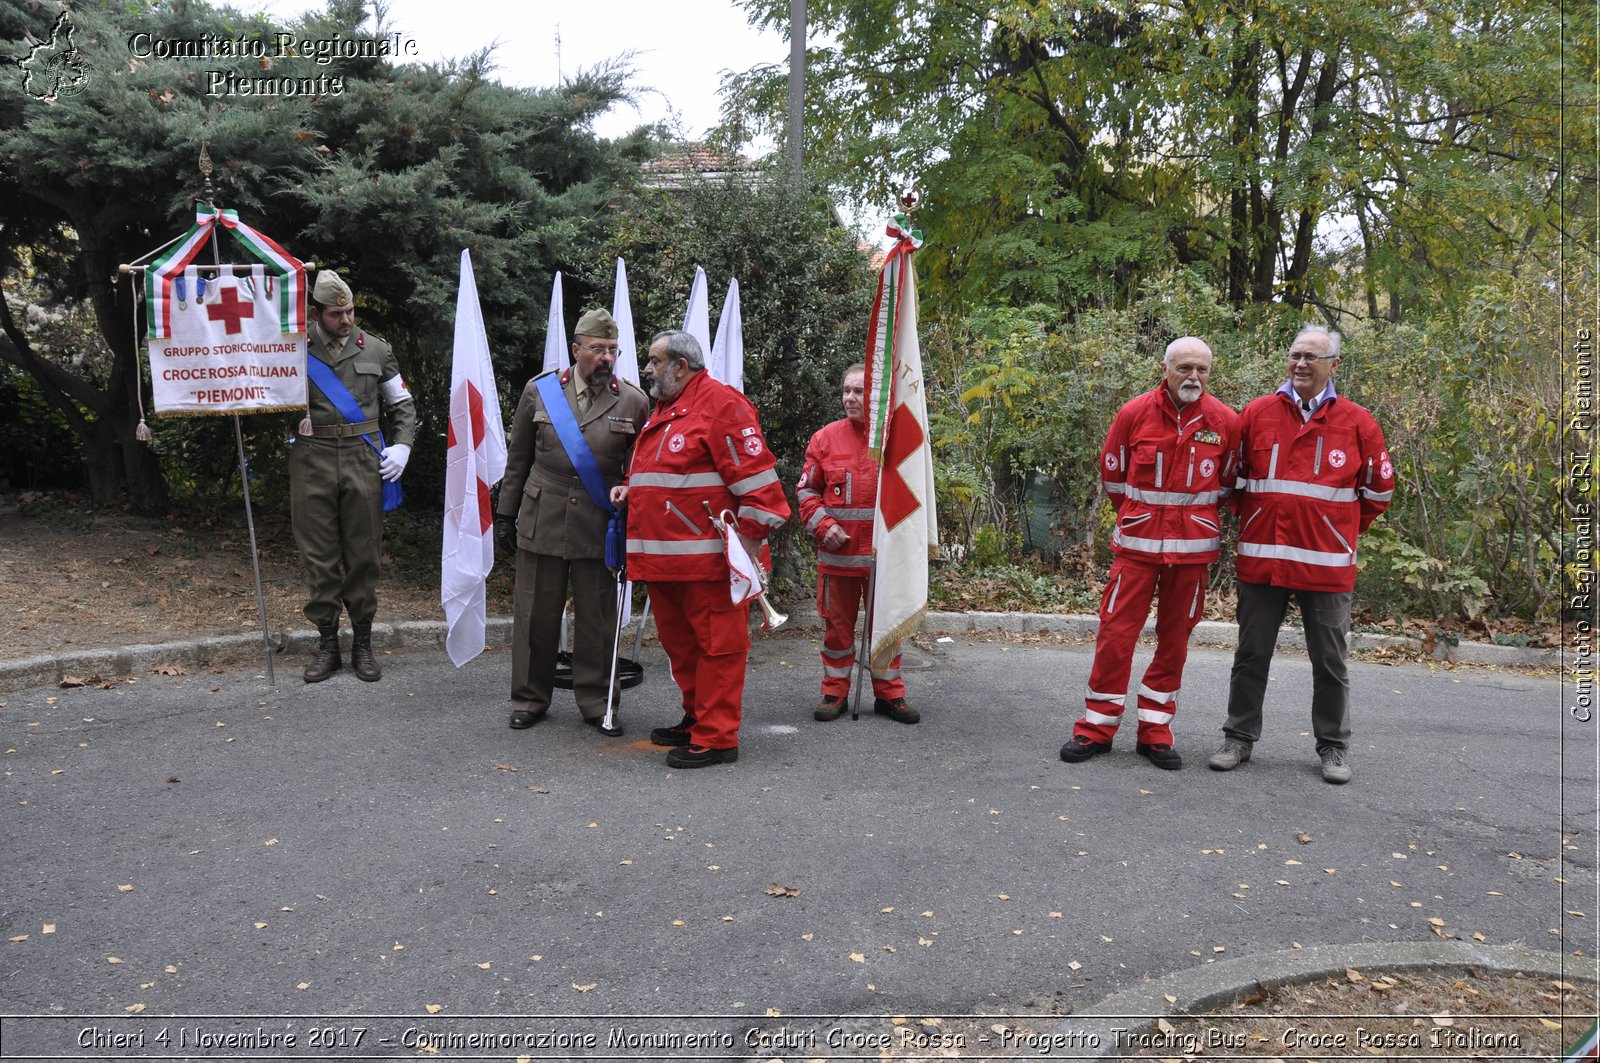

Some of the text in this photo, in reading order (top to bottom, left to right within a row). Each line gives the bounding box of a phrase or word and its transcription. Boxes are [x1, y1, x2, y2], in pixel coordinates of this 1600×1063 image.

[164, 346, 210, 357] GRUPPO
[163, 365, 298, 381] CROCE ROSSA ITALIANA
[190, 386, 271, 403] "PIEMONTE"
